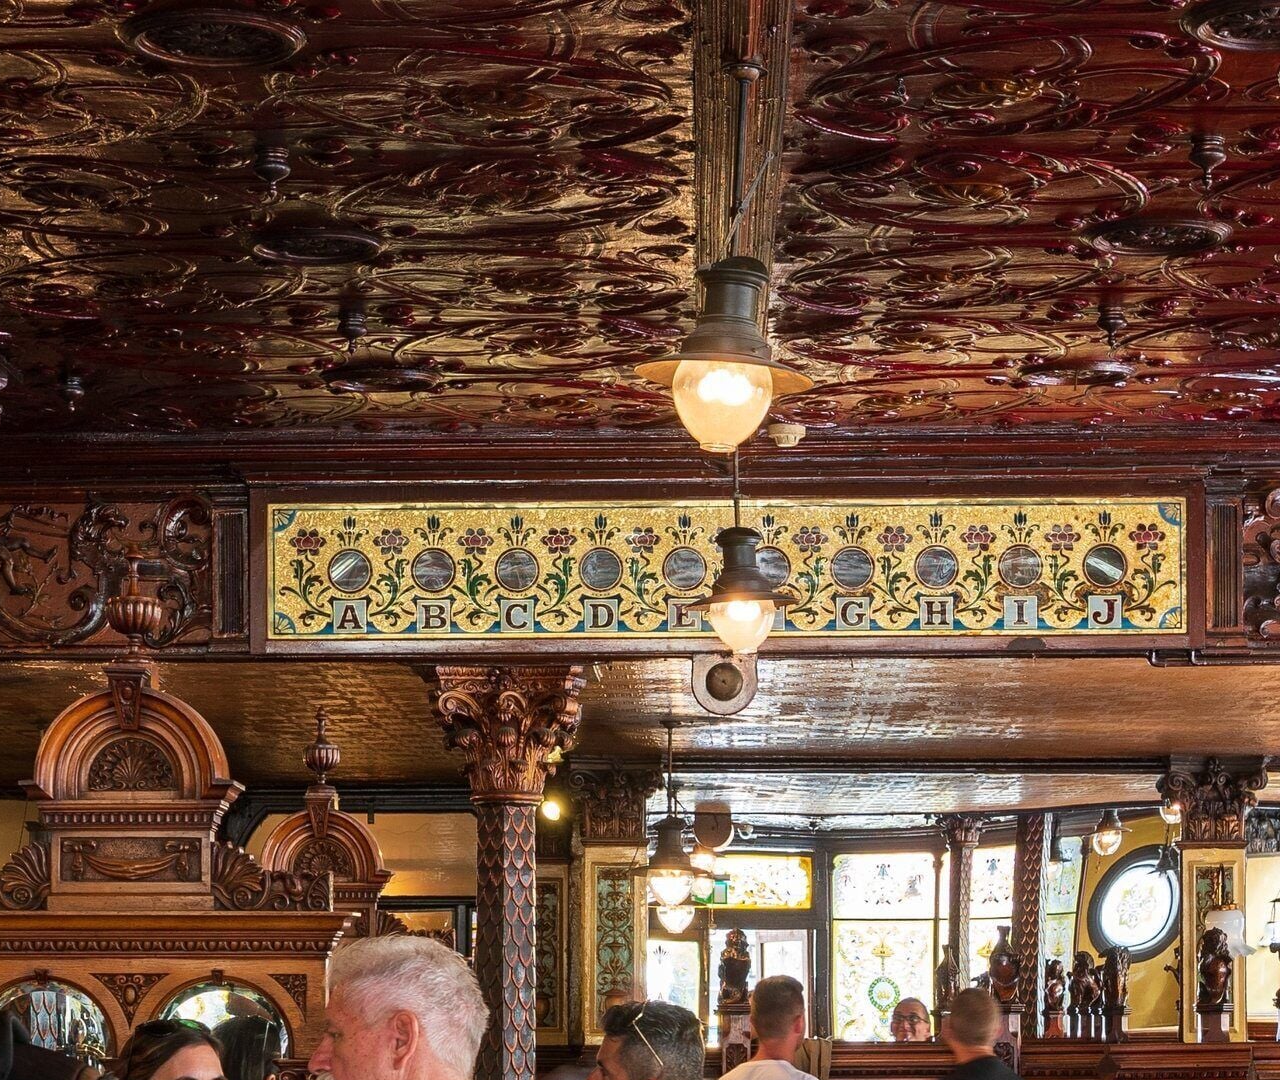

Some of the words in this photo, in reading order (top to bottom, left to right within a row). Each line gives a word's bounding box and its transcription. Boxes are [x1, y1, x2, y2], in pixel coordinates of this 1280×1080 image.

[337, 604, 363, 630] A
[422, 604, 447, 630] B
[504, 603, 528, 629] C
[588, 603, 615, 629] D
[672, 603, 696, 628] E
[840, 601, 866, 626] G
[924, 600, 950, 626] H
[1013, 599, 1028, 625] I
[1092, 599, 1118, 625] J
